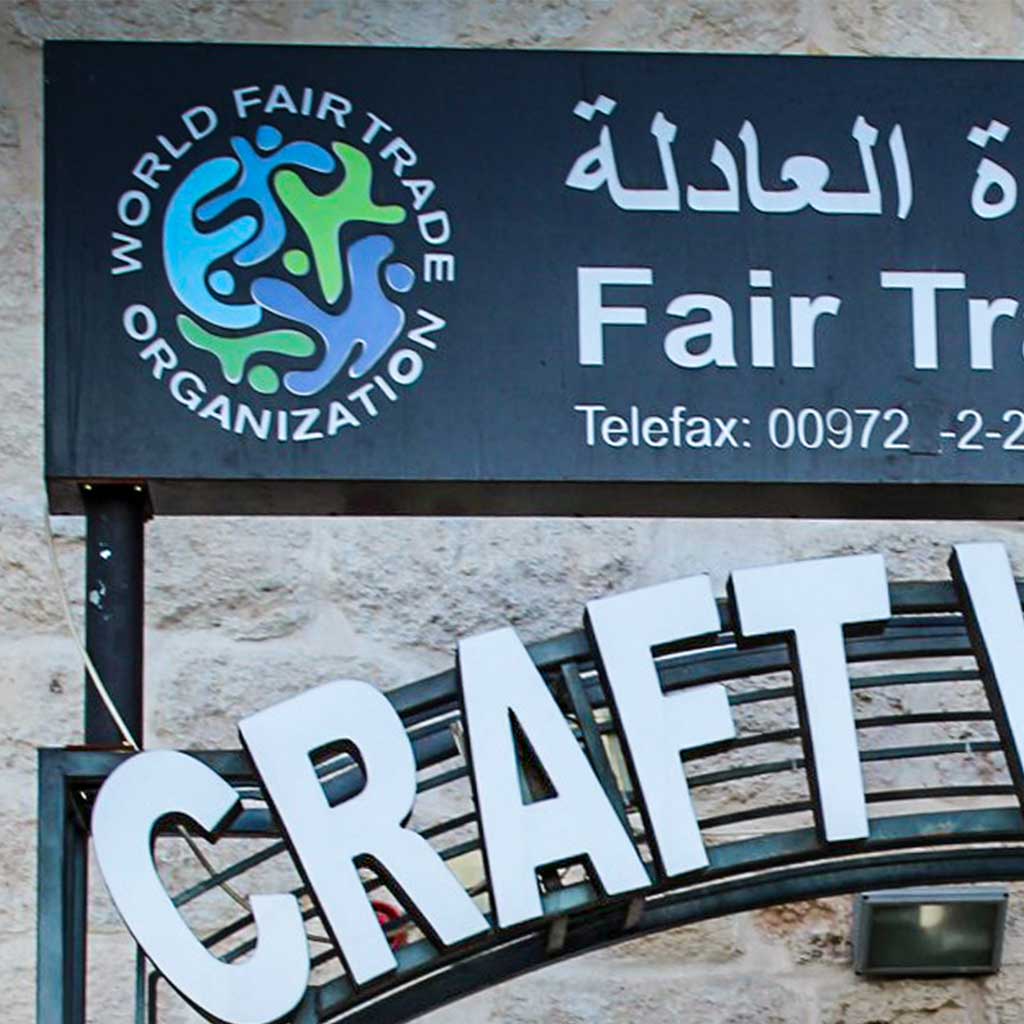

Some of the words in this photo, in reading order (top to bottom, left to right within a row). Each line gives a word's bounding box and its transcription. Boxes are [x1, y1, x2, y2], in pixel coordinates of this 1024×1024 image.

[110, 104, 219, 276] WORLD
[232, 83, 353, 129] FAIR
[362, 112, 456, 283] TRADE
[564, 94, 913, 219] العادلة
[122, 303, 447, 442] ORGANIZATION
[576, 266, 842, 368] Fair
[573, 404, 752, 449] Telefax:
[767, 407, 911, 450] 00972
